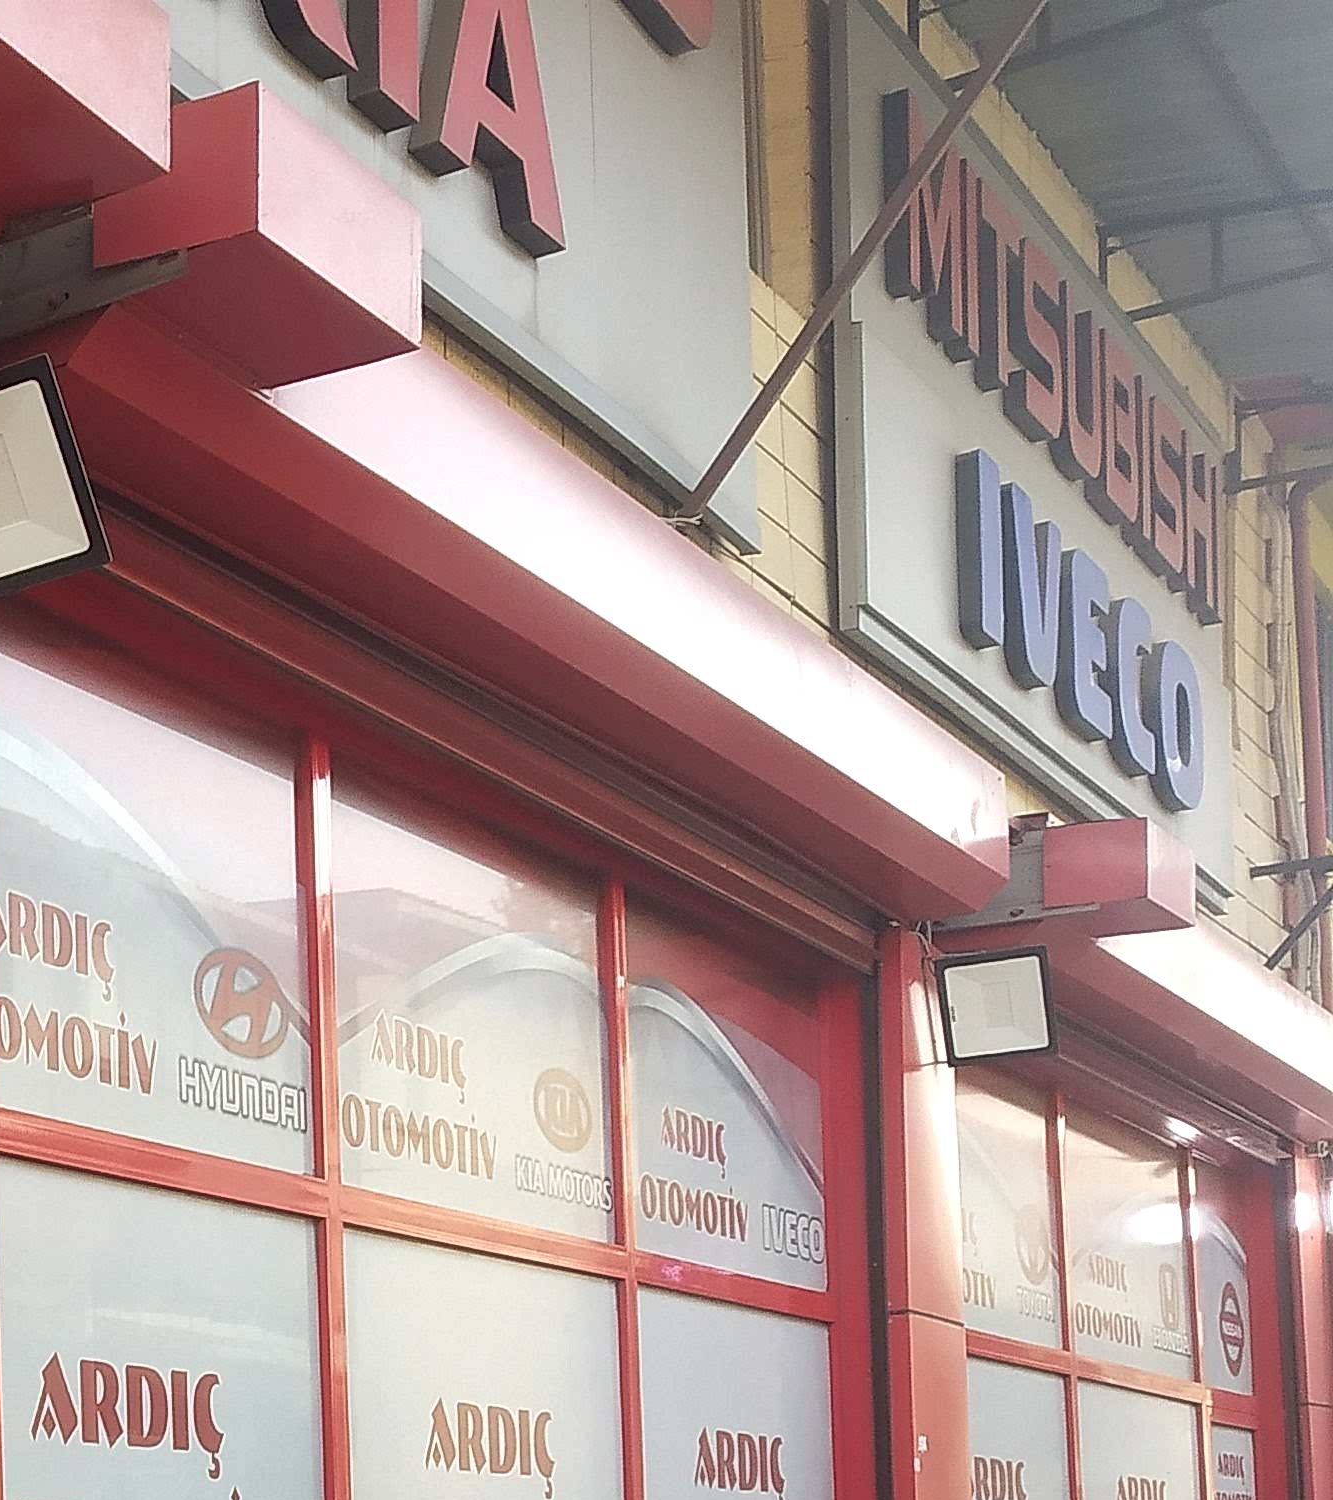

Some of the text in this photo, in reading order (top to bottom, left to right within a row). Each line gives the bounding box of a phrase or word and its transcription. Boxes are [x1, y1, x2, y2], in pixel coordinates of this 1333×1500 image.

[883, 88, 1226, 628] MITSUBISHI
[955, 449, 1203, 813] IVECO
[179, 1060, 307, 1132] HYUNDAI
[371, 1010, 467, 1104] ARDIÇ
[342, 1094, 496, 1181] OTOMOTİV
[662, 1107, 727, 1178] ARDIÇ
[516, 1154, 613, 1212] KIA MOTORS
[641, 1178, 749, 1243] OTOMOTİV
[761, 1203, 827, 1266] IVECO
[31, 1352, 225, 1480] ARDIÇ
[425, 1398, 556, 1500] ARDIÇ
